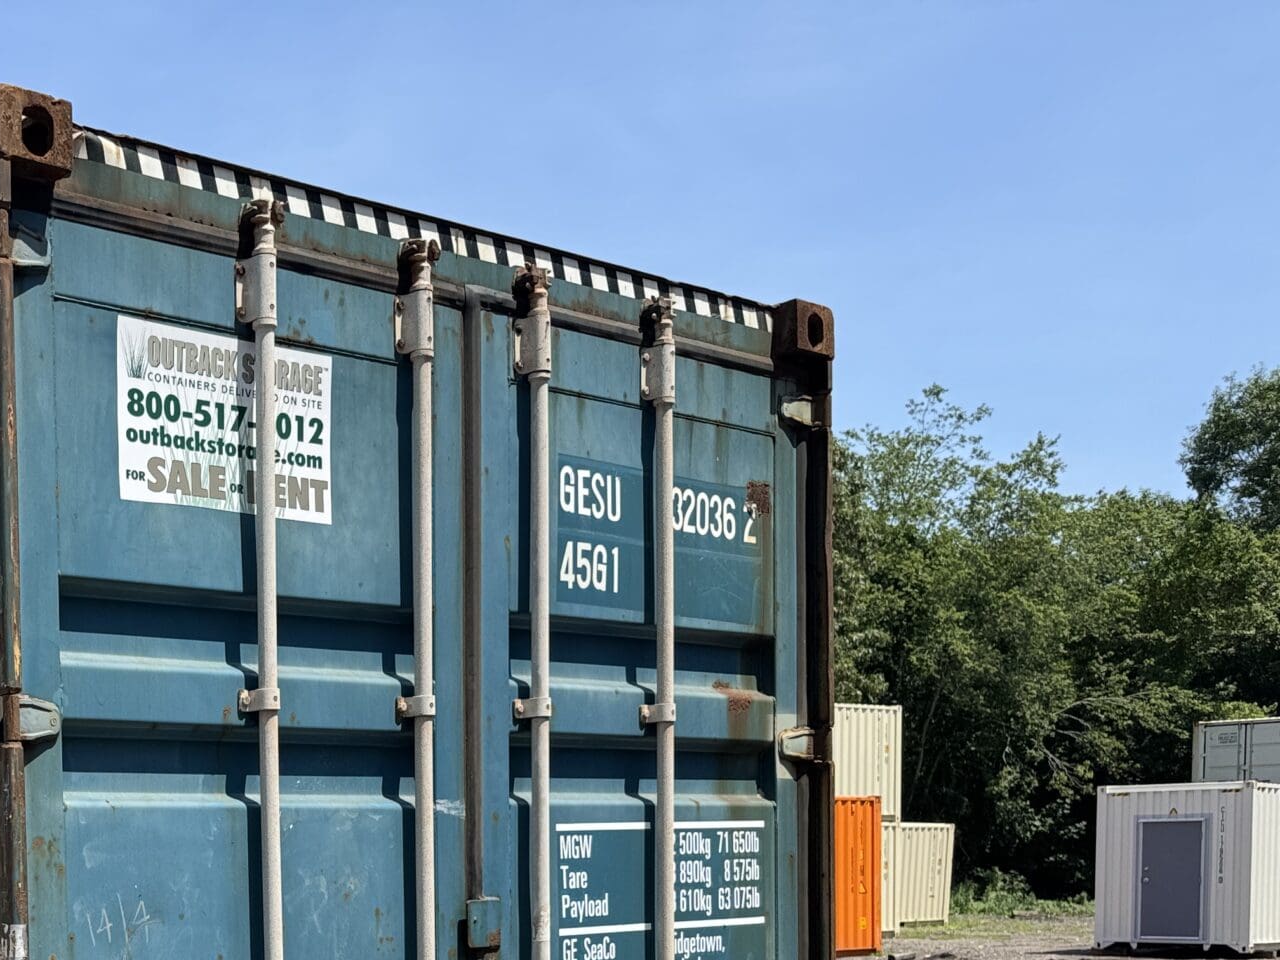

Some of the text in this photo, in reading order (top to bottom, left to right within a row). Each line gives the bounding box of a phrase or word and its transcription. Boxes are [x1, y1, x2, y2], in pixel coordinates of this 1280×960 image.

[147, 335, 323, 396] OUTBACK SRAGE
[148, 372, 217, 392] CONTAINERS
[283, 395, 297, 406] ON
[302, 398, 322, 410] SITE
[127, 388, 324, 445] 800-517-012
[126, 425, 323, 469] outbackstorae.com
[126, 469, 146, 482] FOR
[147, 456, 226, 501] SALE
[229, 483, 244, 494] OR
[559, 465, 621, 522] GESU
[673, 486, 736, 540] 32036
[560, 541, 619, 593] 45G1
[560, 835, 592, 859] MGW
[679, 832, 711, 860] 500kg
[717, 831, 729, 853] 71
[733, 831, 759, 853] 650lb
[560, 865, 588, 889] Tare
[680, 860, 712, 888] 890kg
[724, 860, 731, 882] 8
[733, 859, 760, 881] 575lb
[561, 893, 609, 923] Payload
[680, 889, 712, 916] 610kg
[718, 887, 731, 910] 63
[734, 887, 760, 909] 075lb
[584, 936, 616, 960] SeaCo
[674, 931, 726, 959] idgetown,
